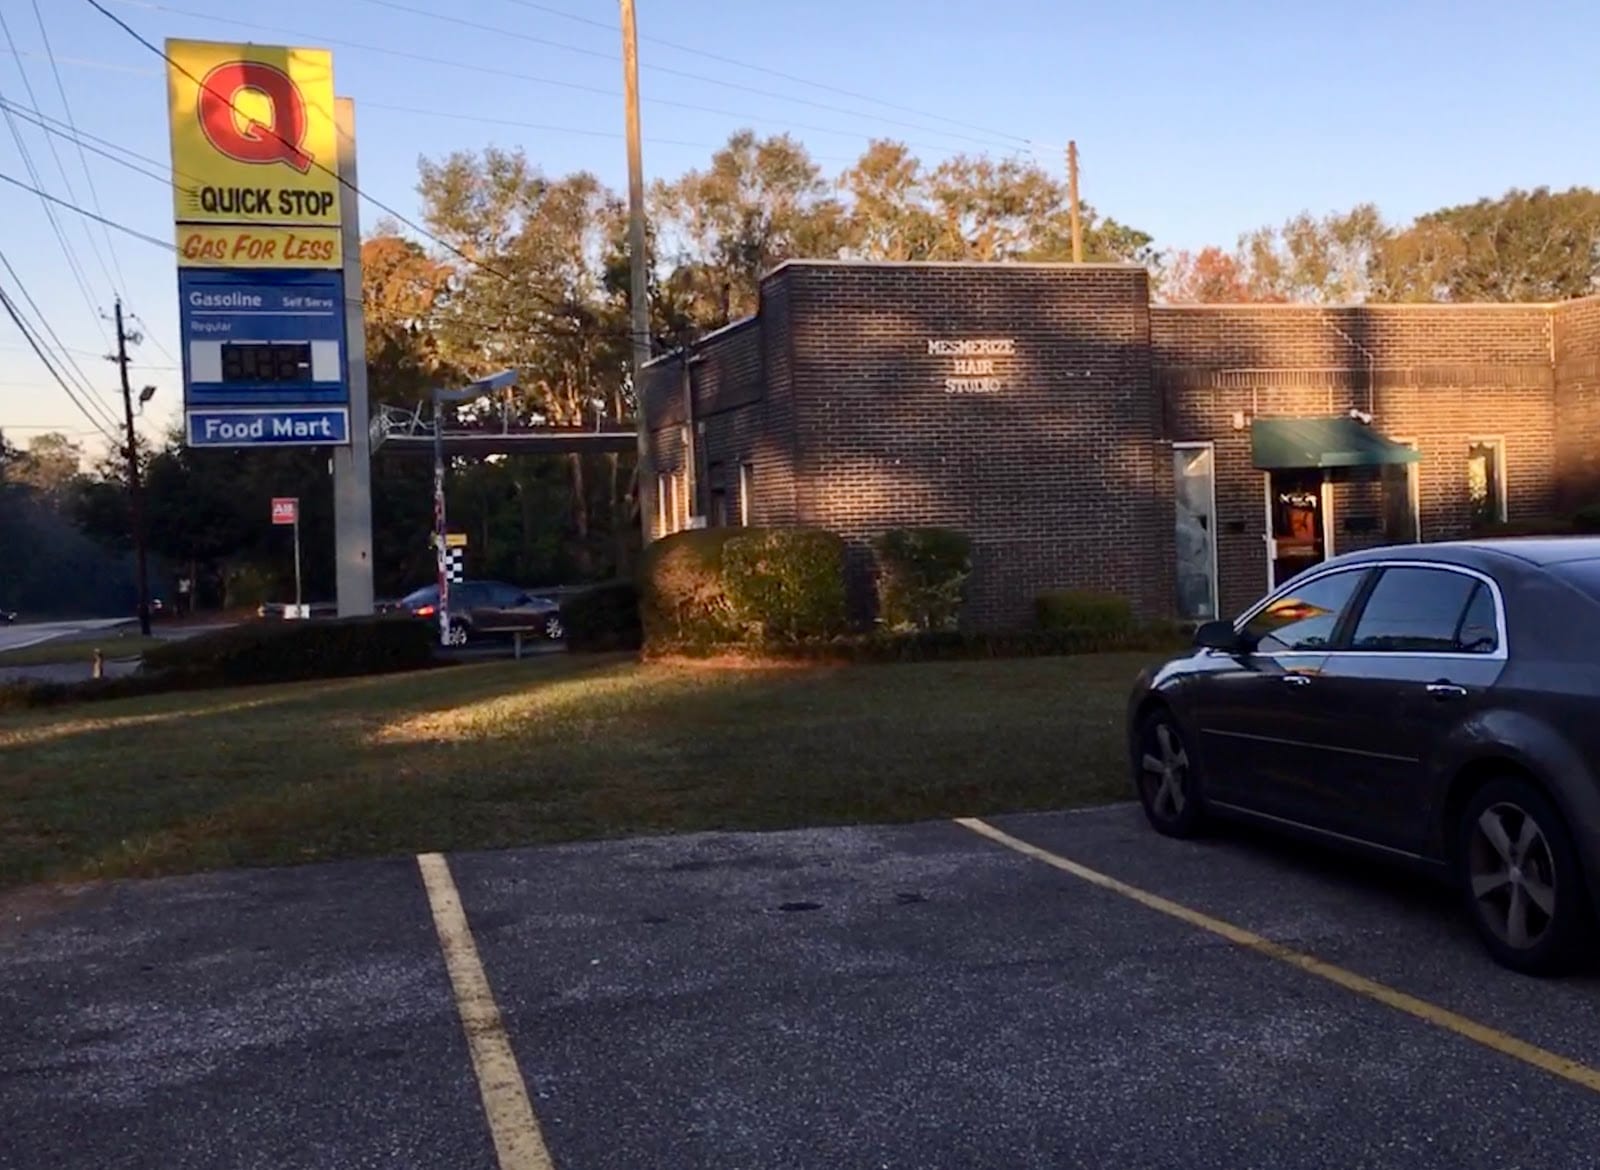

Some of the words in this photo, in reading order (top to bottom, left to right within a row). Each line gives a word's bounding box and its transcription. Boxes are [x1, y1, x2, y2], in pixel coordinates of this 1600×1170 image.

[197, 60, 315, 176] Q
[201, 186, 273, 214] QUICK
[279, 189, 334, 216] STOP
[189, 291, 261, 307] Gasoline
[190, 320, 231, 332] Regular
[928, 340, 1016, 355] MESMERIZE
[954, 359, 994, 375] HAIR
[944, 378, 1001, 393] STUDIO
[205, 419, 263, 440] Food
[272, 416, 332, 437] Mart
